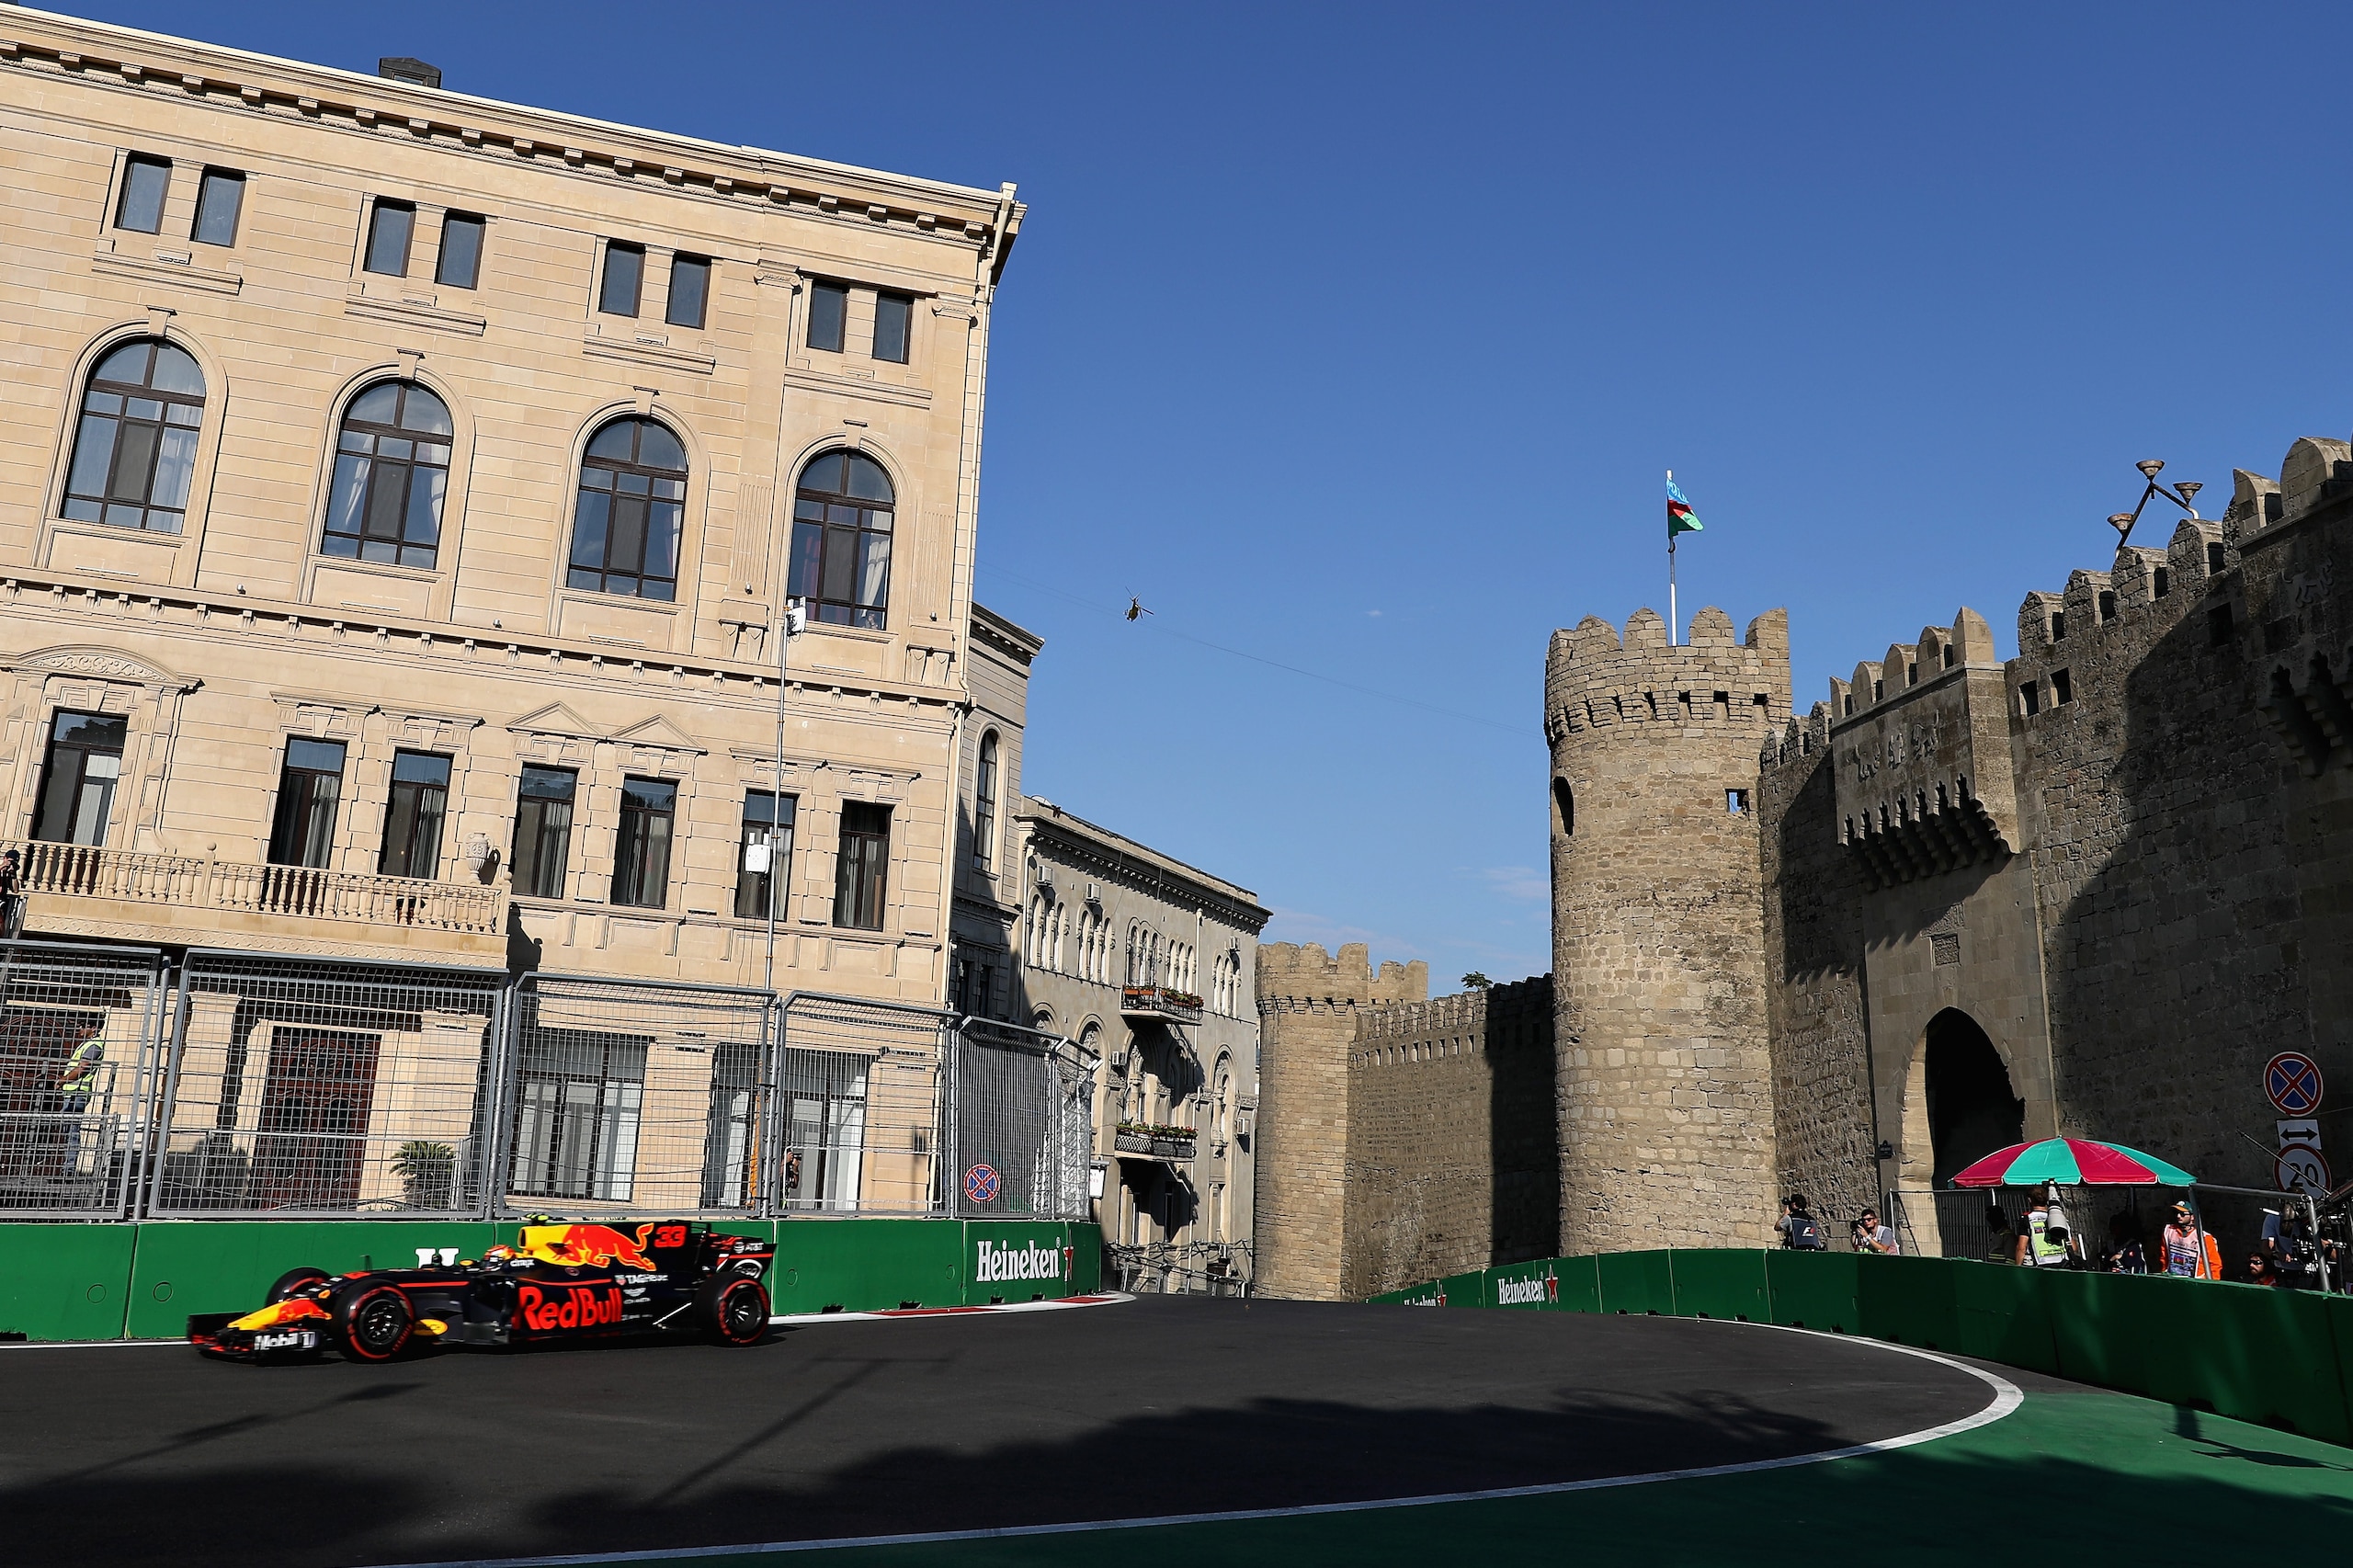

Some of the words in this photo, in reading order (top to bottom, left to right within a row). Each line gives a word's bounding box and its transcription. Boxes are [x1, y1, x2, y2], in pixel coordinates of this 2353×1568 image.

[2289, 1163, 2319, 1188] 20
[654, 1226, 687, 1248] 33
[976, 1240, 1060, 1282] Heineken
[1498, 1276, 1545, 1305] Heineken
[254, 1332, 298, 1351] Mobil
